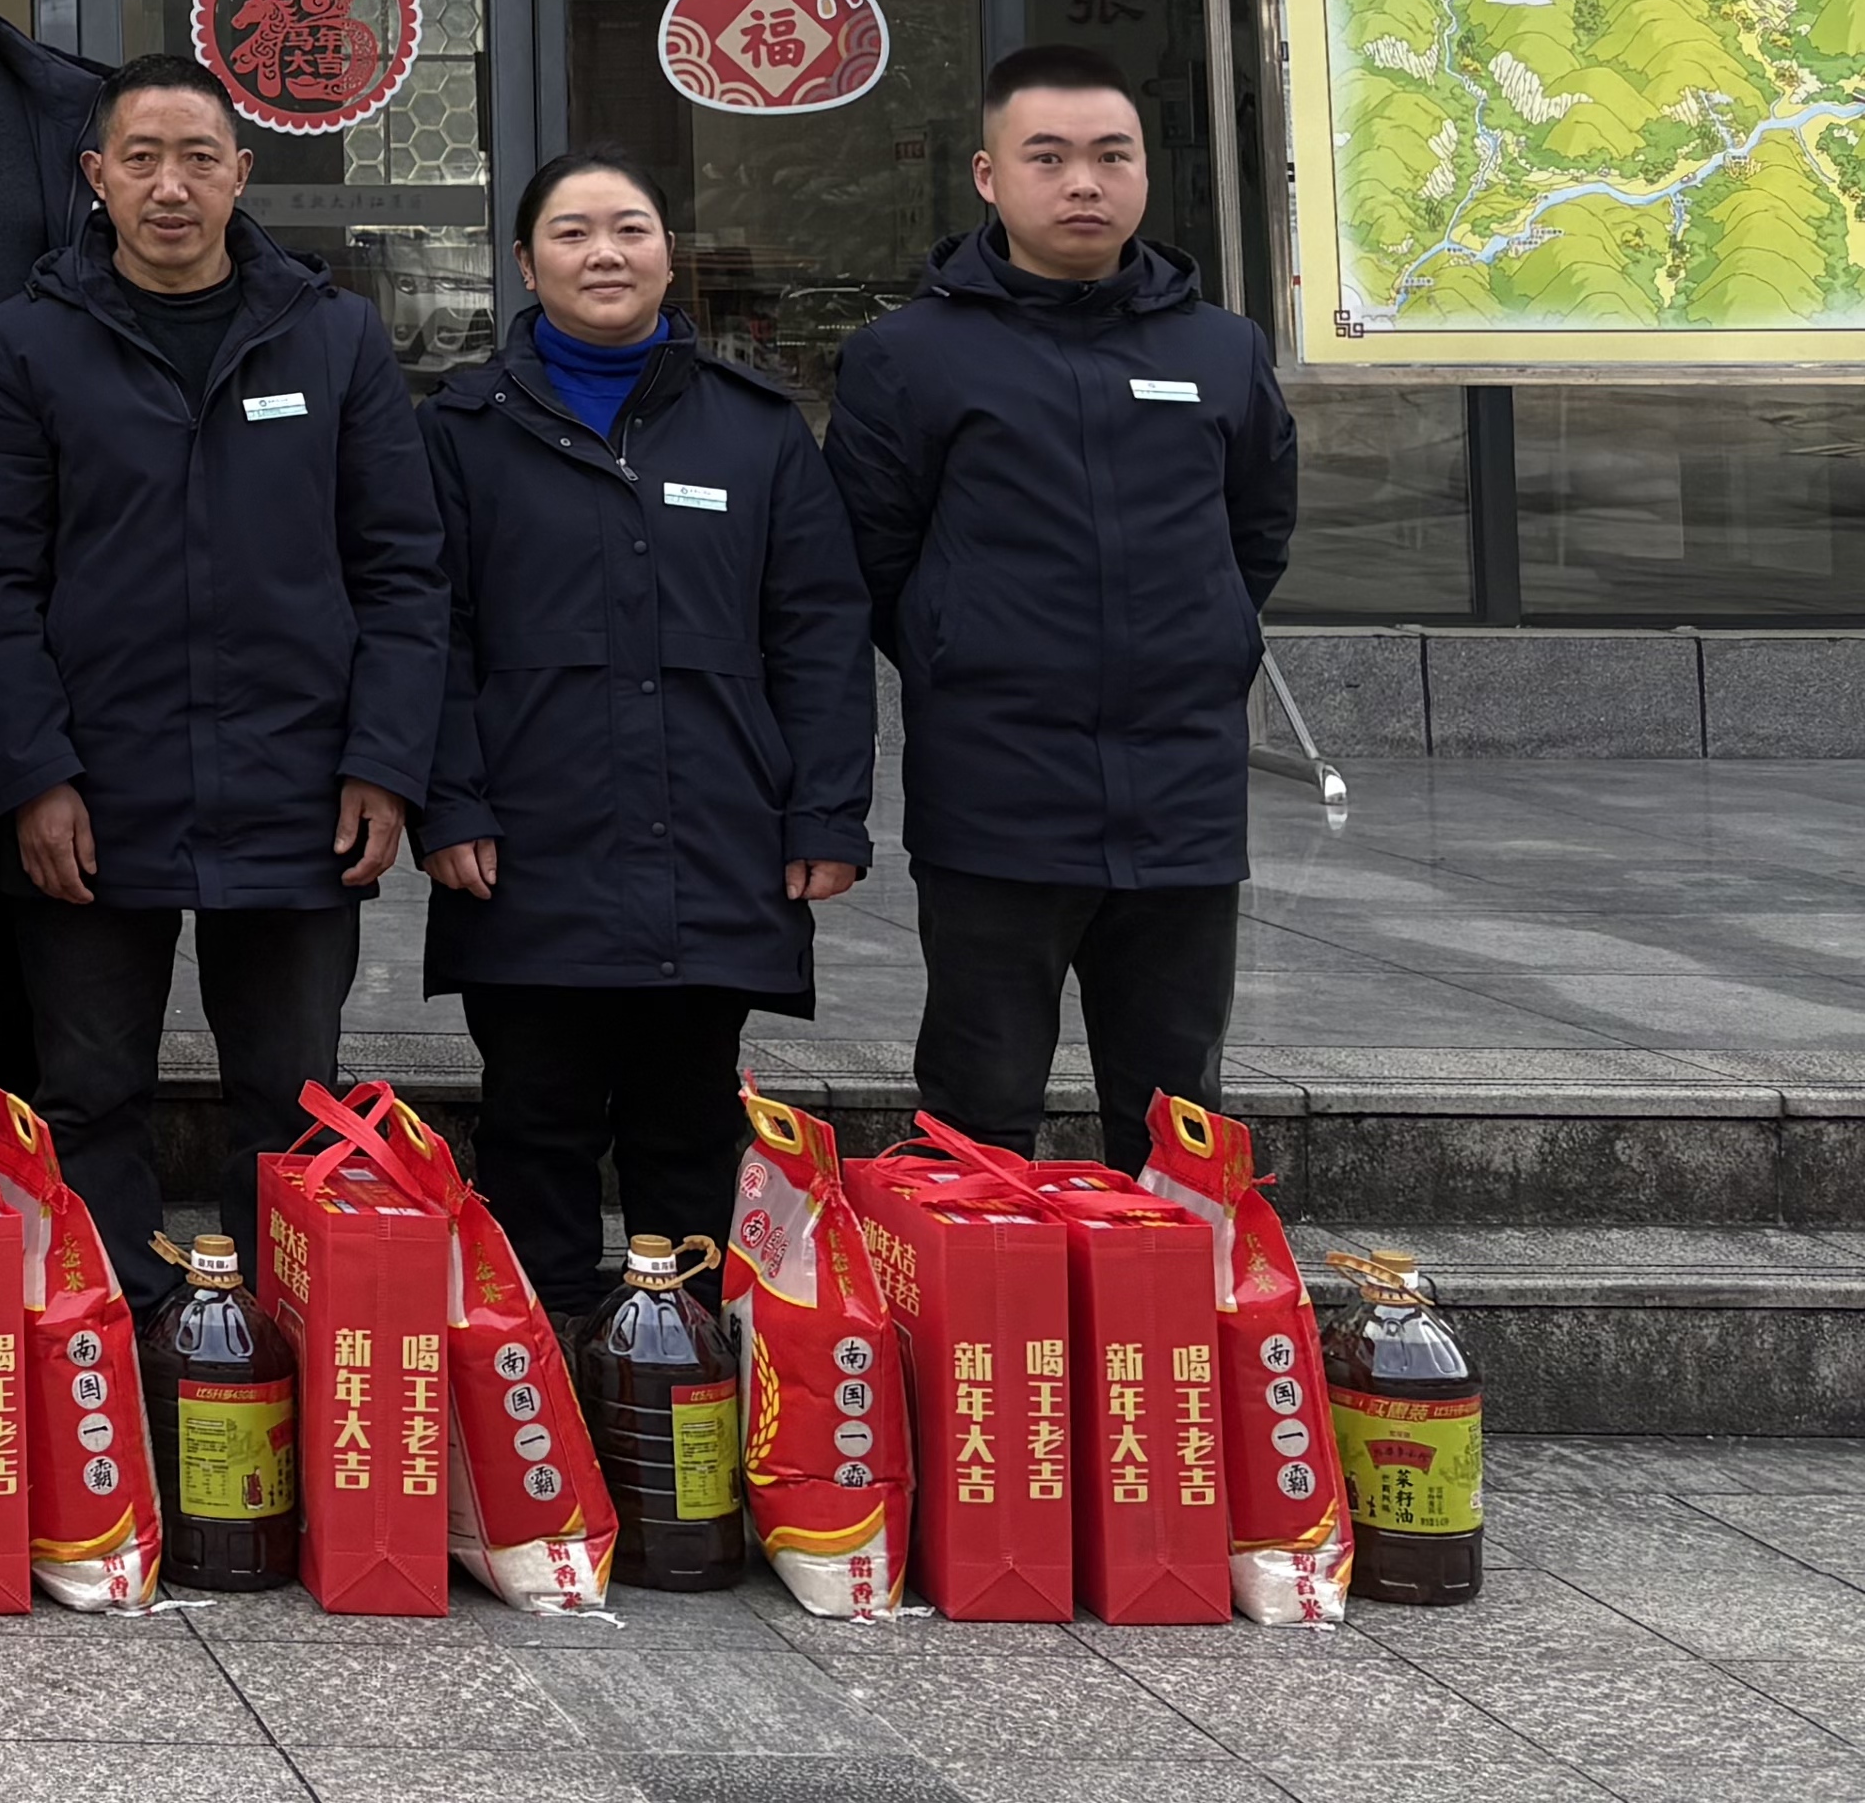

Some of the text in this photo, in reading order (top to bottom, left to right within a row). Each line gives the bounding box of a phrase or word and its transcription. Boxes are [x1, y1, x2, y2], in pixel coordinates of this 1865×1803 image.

[740, 8, 806, 69] 福
[72, 1334, 116, 1492] 南国一霸
[334, 1328, 372, 1489] 新年大吉
[401, 1335, 439, 1495] 喝王老吉
[499, 1346, 559, 1499] 南国一霸
[954, 1342, 995, 1503] 新年大吉
[1026, 1339, 1064, 1499] 喝王老吉
[1106, 1343, 1148, 1504] 新年大吉
[1173, 1345, 1215, 1506] 喝王老吉
[1266, 1337, 1314, 1495] 南国一霸
[1394, 1468, 1415, 1525] 菜籽油
[1290, 1552, 1325, 1622] 稻香米
